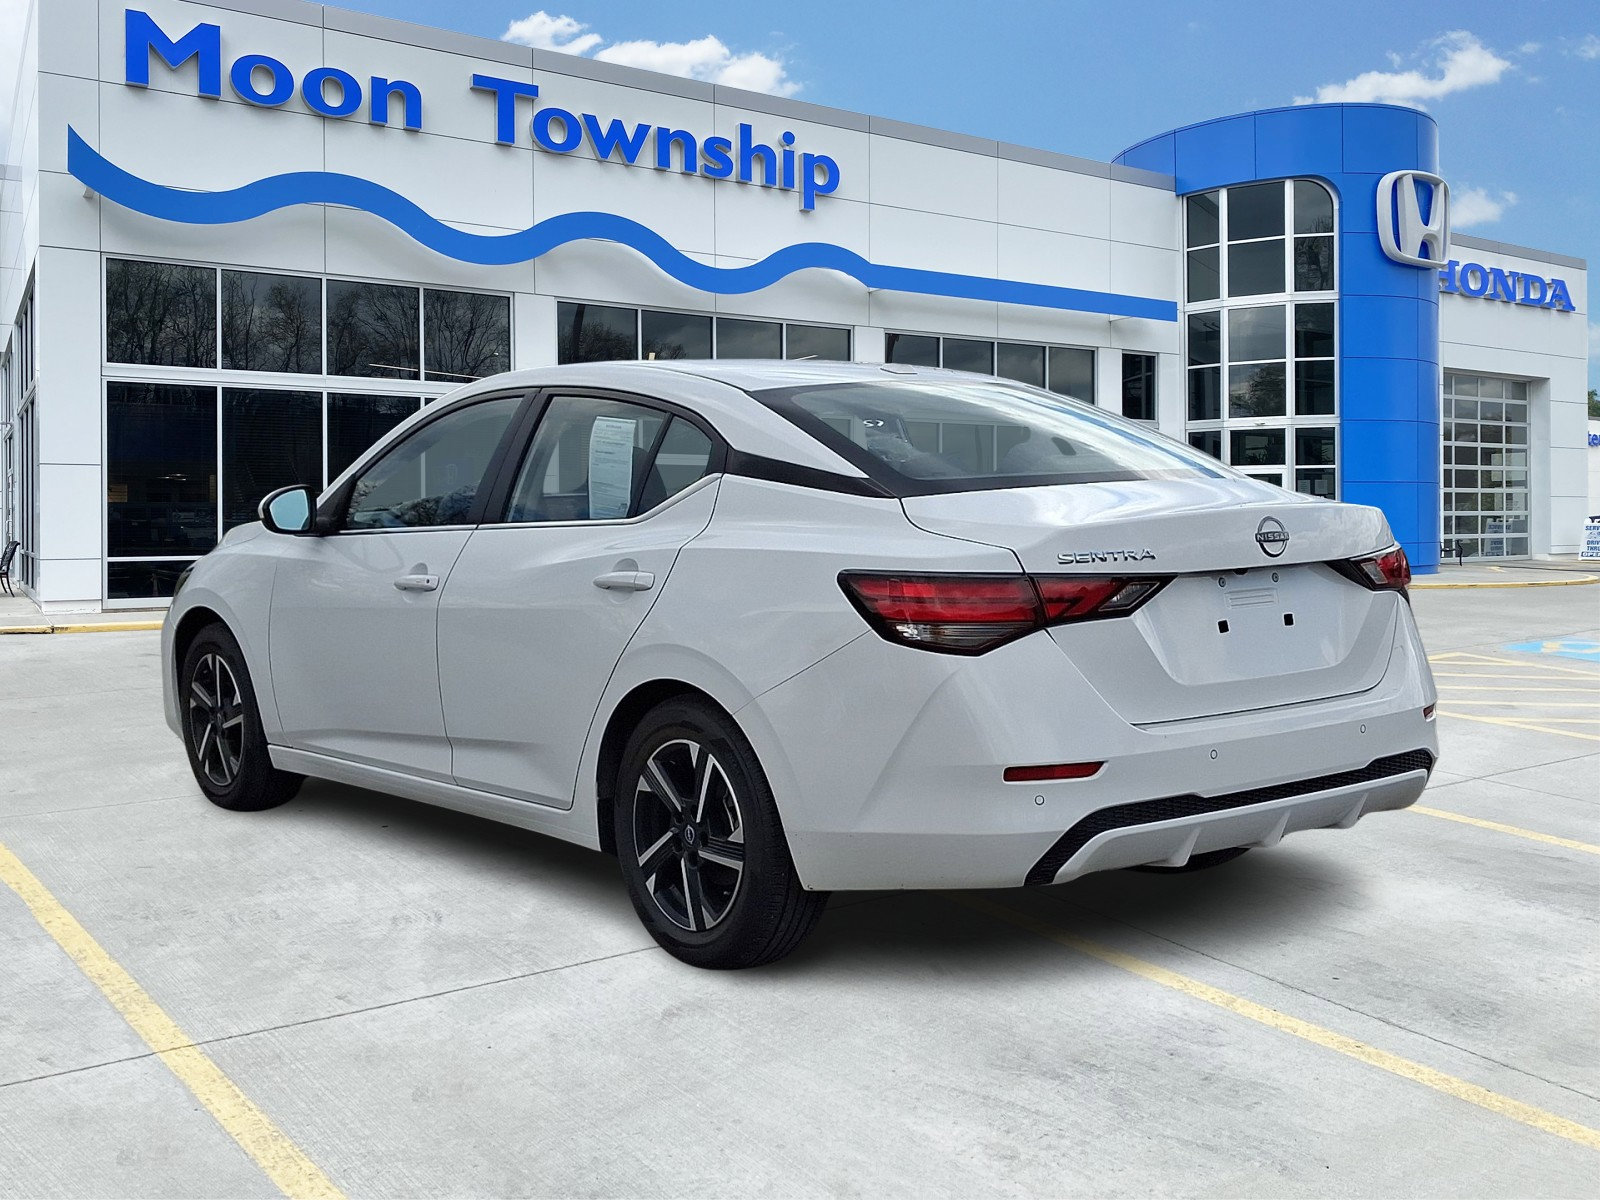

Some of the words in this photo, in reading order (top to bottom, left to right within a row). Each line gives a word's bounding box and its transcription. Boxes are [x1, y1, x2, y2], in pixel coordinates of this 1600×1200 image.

[124, 8, 423, 131] Moon
[470, 73, 841, 212] Township
[1057, 548, 1157, 565] SENTRA
